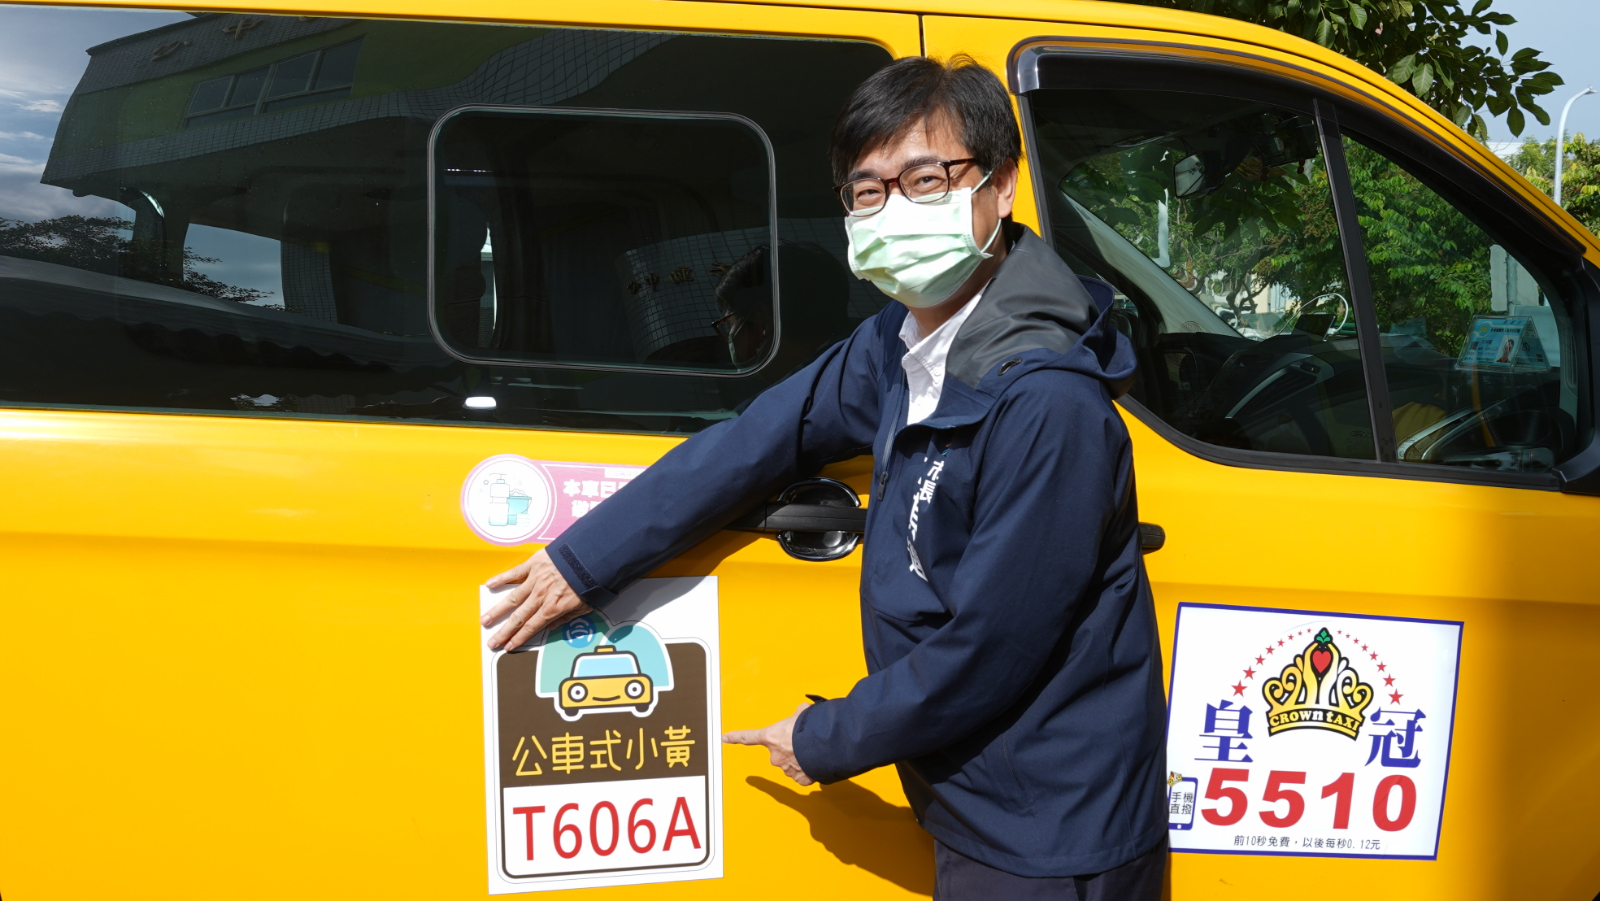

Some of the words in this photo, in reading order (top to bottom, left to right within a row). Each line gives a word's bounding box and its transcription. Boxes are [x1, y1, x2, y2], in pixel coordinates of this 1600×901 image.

[563, 478, 632, 499] 本車已
[512, 724, 696, 777] 公車式小黃
[1194, 699, 1254, 763] 皇
[1364, 706, 1427, 768] 冠
[1169, 803, 1192, 815] 直撥
[1170, 791, 1194, 804] 手機
[1201, 767, 1417, 832] 5510
[512, 796, 702, 862] T606A
